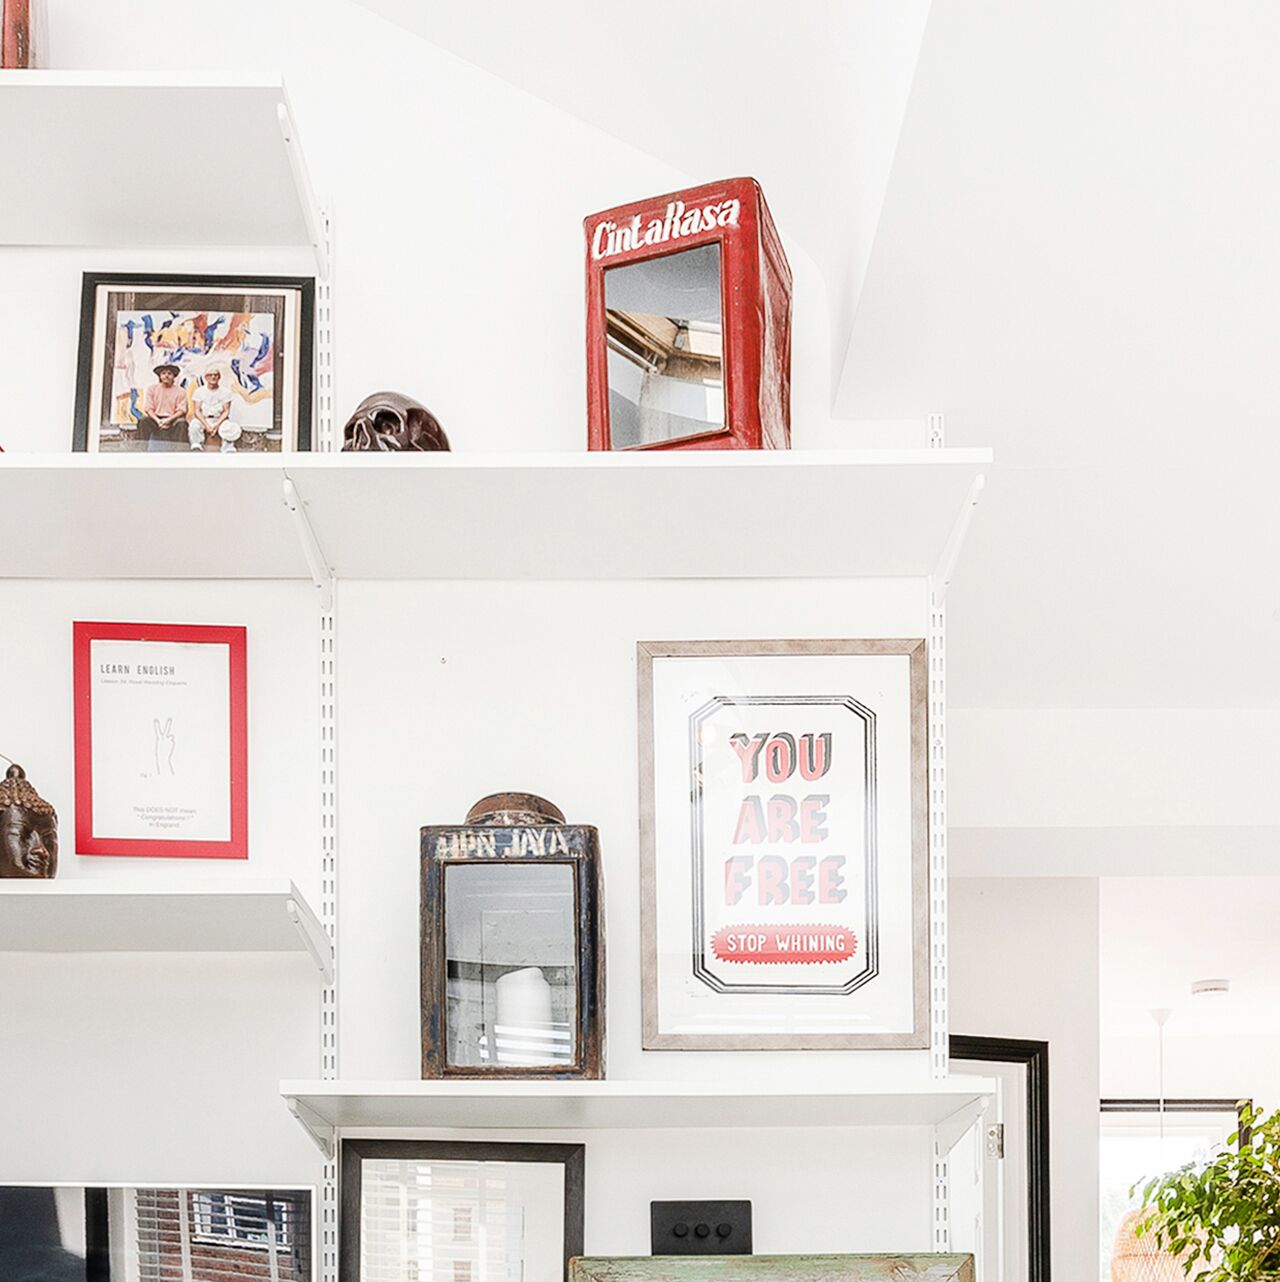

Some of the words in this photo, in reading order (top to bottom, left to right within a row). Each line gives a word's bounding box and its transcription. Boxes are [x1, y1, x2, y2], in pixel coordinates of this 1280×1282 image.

[100, 664, 131, 674] LEARN
[137, 665, 176, 676] ENGLISH
[729, 732, 833, 784] YOU
[732, 794, 832, 846] ARE
[502, 828, 569, 858] JAYA
[724, 855, 848, 906] FREE
[727, 933, 767, 953] STOP
[777, 933, 846, 953] WHINING
